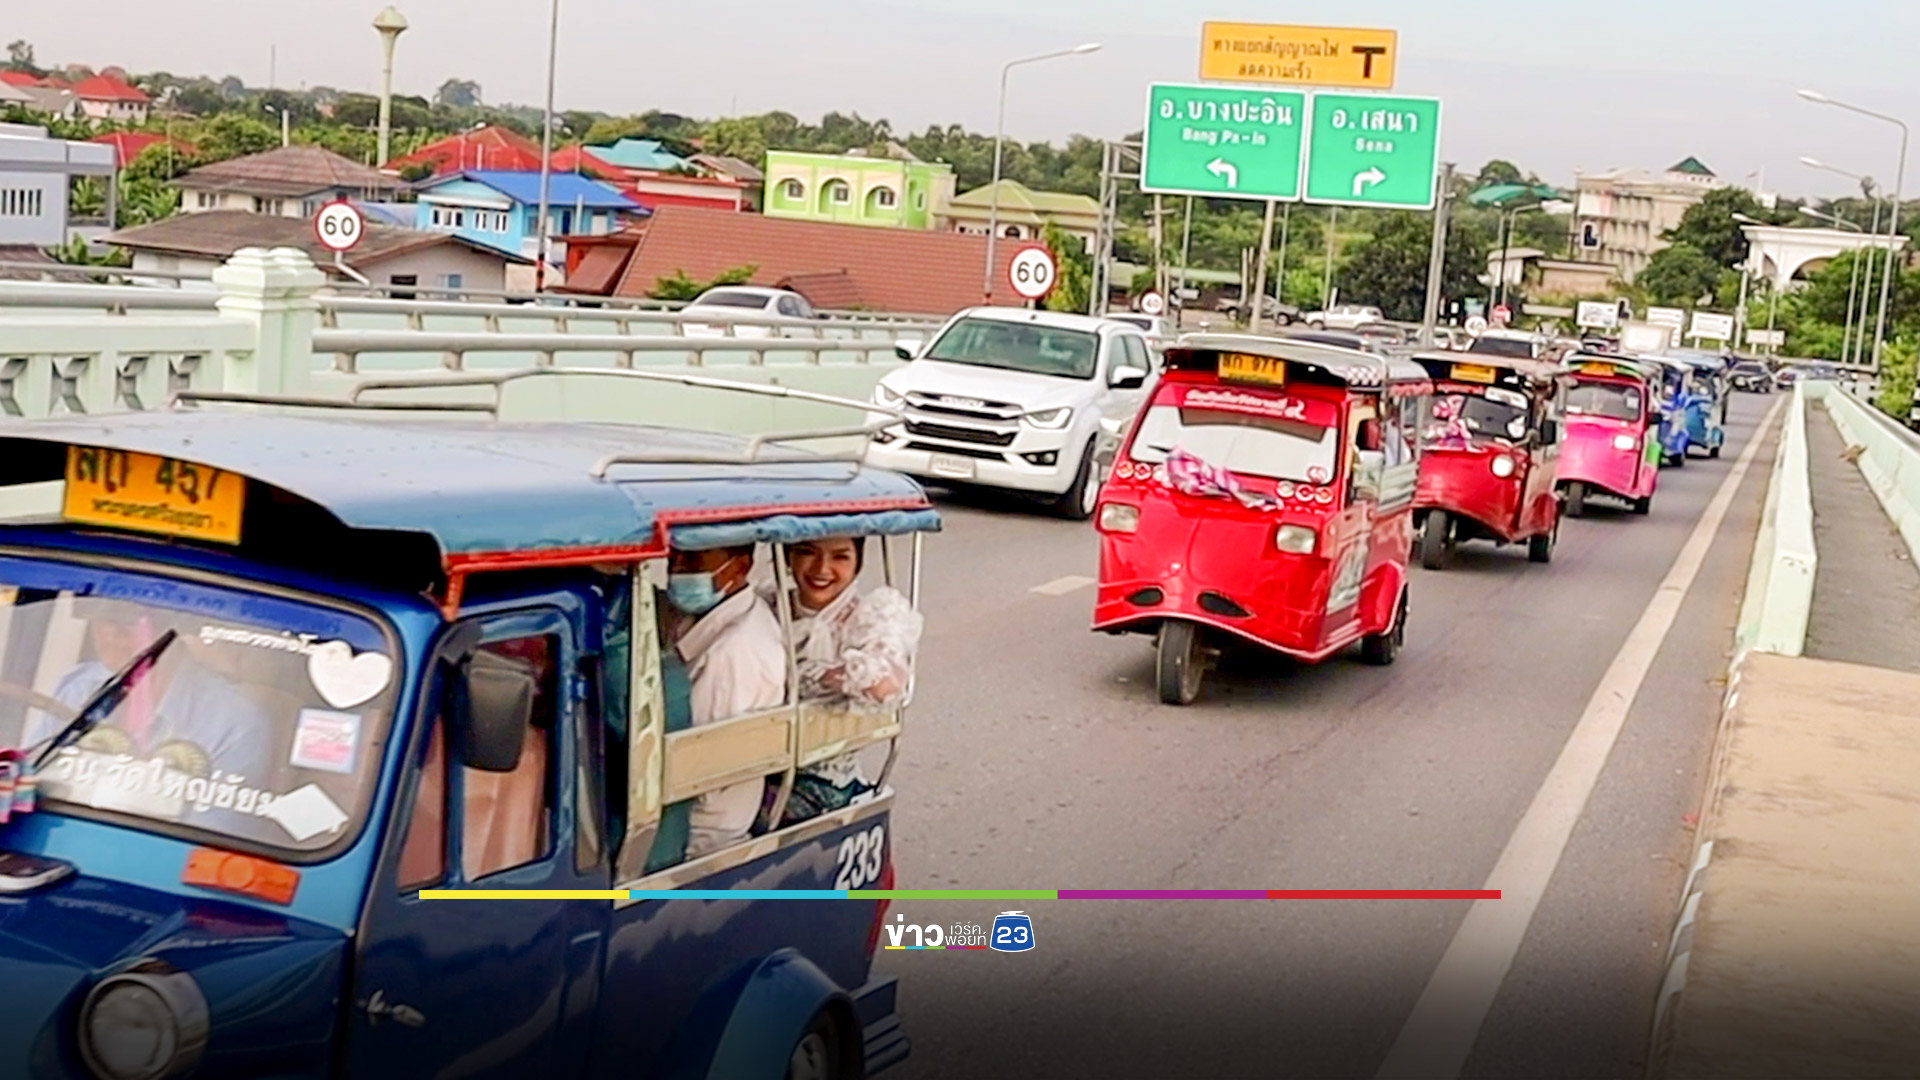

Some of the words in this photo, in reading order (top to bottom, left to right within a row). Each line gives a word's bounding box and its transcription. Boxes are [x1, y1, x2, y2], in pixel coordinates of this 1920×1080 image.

[1182, 127, 1218, 146] Bang
[1355, 137, 1393, 153] Sena
[324, 214, 355, 238] 60
[1016, 260, 1048, 284] 60
[155, 456, 223, 504] 457
[835, 825, 884, 890] 233
